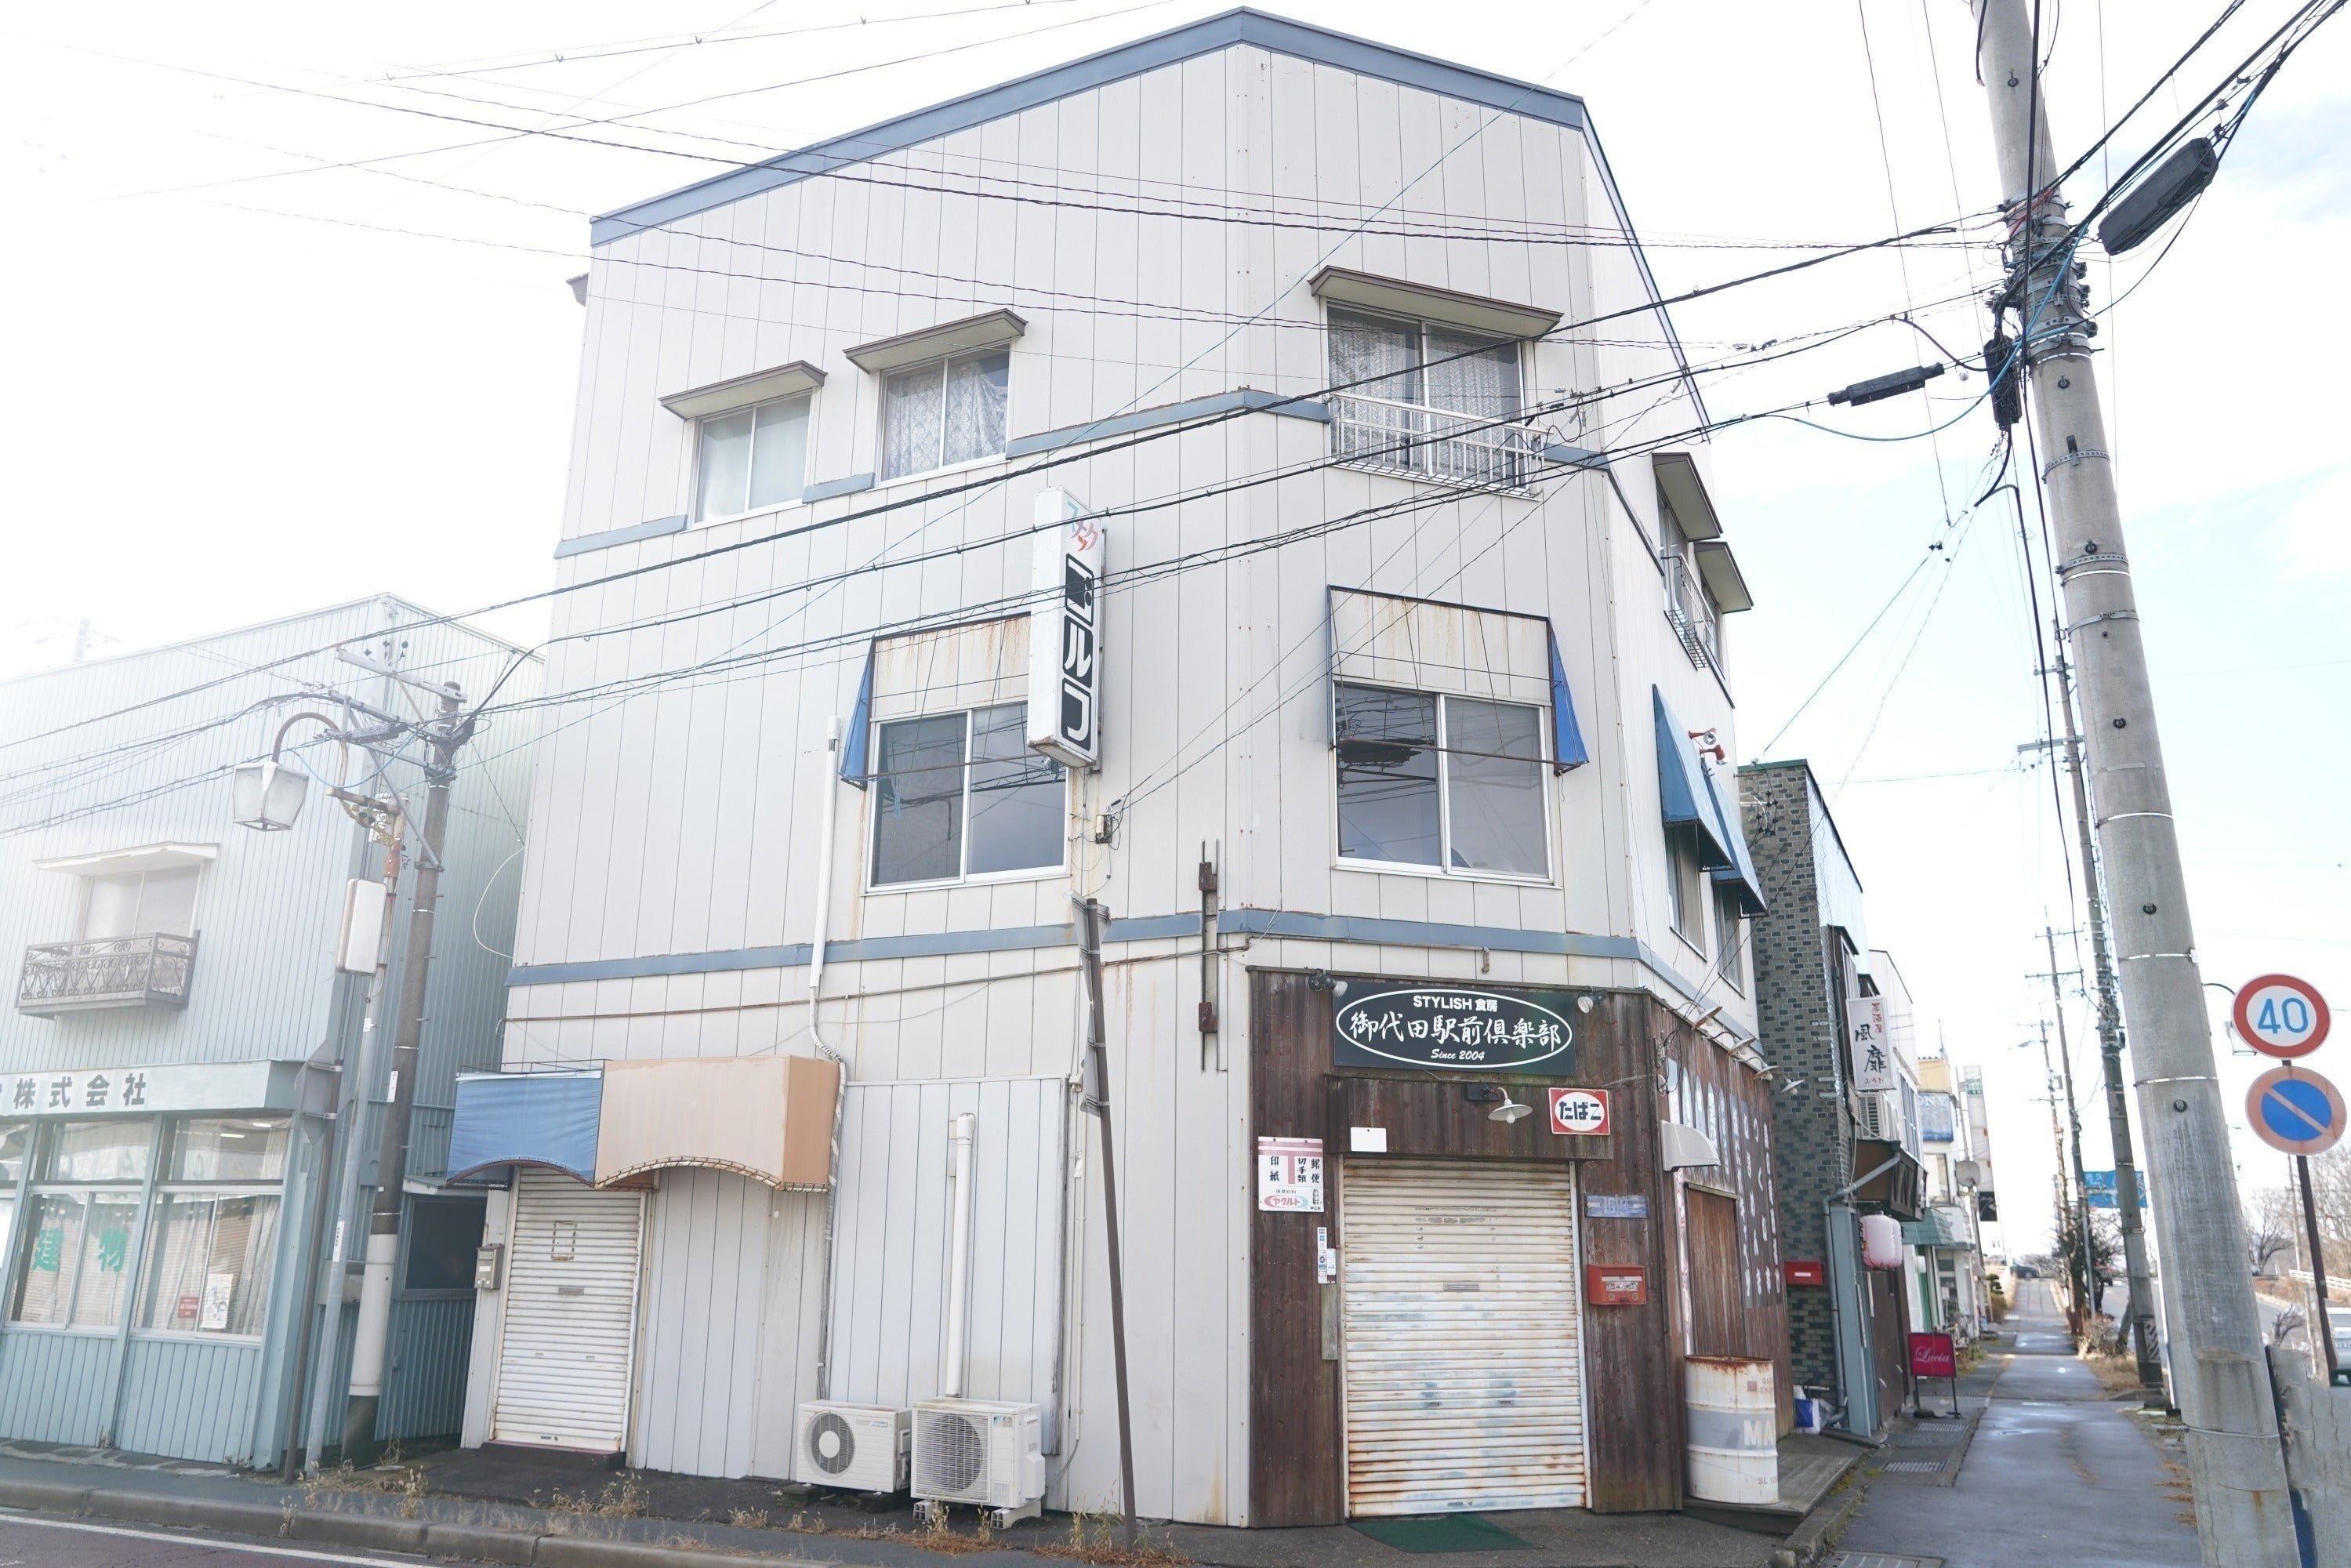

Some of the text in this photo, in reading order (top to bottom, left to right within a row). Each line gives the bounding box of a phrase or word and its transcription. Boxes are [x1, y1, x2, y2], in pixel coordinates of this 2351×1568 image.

[1413, 995, 1498, 1012] STYLISH 食房
[2258, 997, 2309, 1034] 40
[1431, 1048, 1486, 1062] Since 2004
[0, 1073, 146, 1109] 株式会社
[1558, 1101, 1602, 1121] たばこ
[1269, 1156, 1280, 1182] 印紙
[1297, 1157, 1308, 1184] 切手類
[1311, 1158, 1320, 1184] 郵便
[1272, 1197, 1301, 1207] ヤクルト
[31, 1228, 128, 1272] 建物
